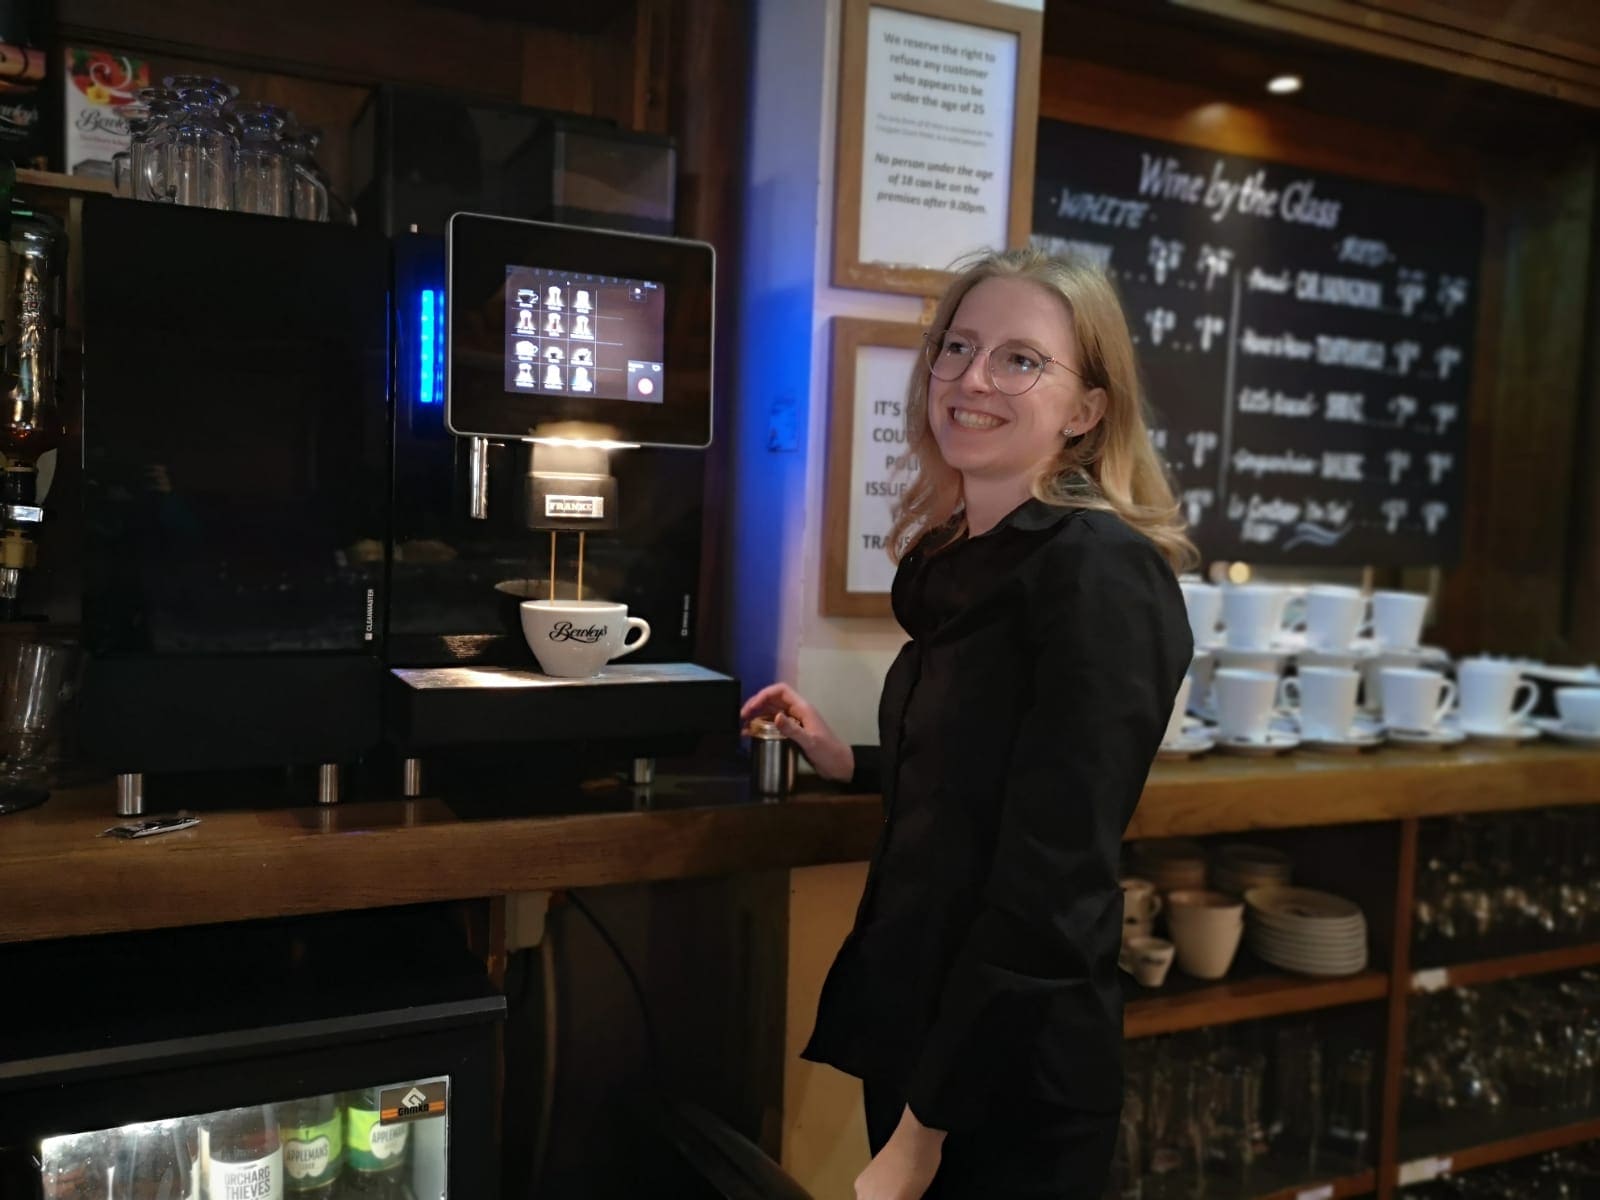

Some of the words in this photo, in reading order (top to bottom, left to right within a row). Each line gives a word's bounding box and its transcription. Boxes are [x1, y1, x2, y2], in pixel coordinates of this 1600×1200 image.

[883, 31, 900, 44] We
[903, 38, 940, 52] reserve
[942, 44, 958, 56] the
[961, 48, 983, 62] right
[985, 52, 996, 63] to
[890, 53, 920, 67] refuse
[924, 60, 941, 74] any
[943, 63, 988, 79] customer
[893, 72, 916, 85] who
[918, 77, 956, 92] appears
[958, 84, 969, 95] to
[970, 84, 984, 96] be
[890, 91, 920, 104] under
[922, 96, 938, 107] the
[941, 100, 958, 112] age
[960, 101, 971, 112] of
[972, 103, 984, 115] 25
[875, 152, 890, 164] No
[891, 156, 925, 170] person
[926, 162, 956, 174] under
[957, 165, 974, 177] the
[975, 169, 994, 182] age
[888, 173, 900, 185] of
[901, 174, 914, 186] 18
[915, 178, 932, 189] can
[934, 179, 948, 191] be
[949, 183, 962, 192] on
[963, 183, 980, 196] the
[1138, 153, 1205, 205] Wine
[1203, 159, 1242, 223] by
[1238, 169, 1278, 219] the
[1279, 180, 1343, 230] Glass
[877, 191, 921, 206] premises
[922, 196, 948, 210] after
[874, 400, 901, 417] IT'S
[549, 621, 608, 644] Bewley's
[225, 1179, 270, 1200] THIEVES
